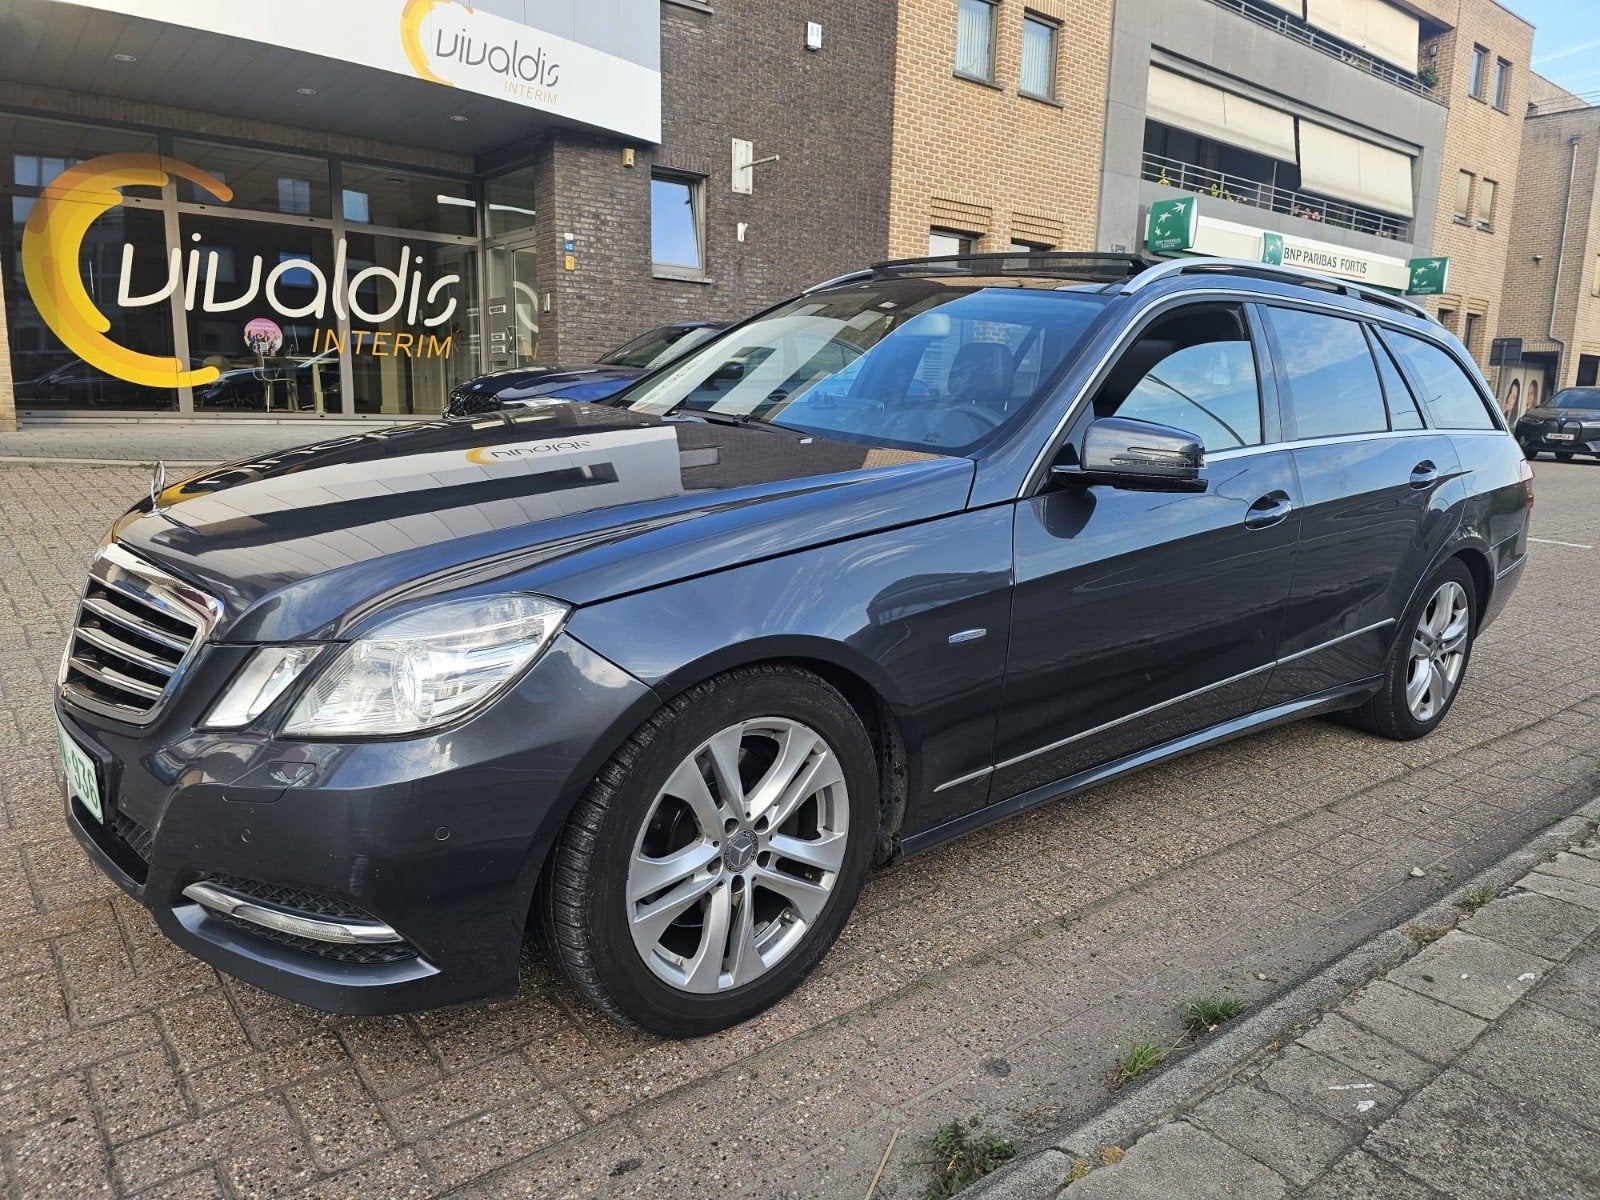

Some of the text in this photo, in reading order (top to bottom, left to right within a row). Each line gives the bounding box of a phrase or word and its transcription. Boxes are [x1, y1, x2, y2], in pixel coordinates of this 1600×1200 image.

[436, 28, 560, 87] vivaldis
[504, 80, 558, 105] INTERIM
[1284, 247, 1367, 273] BNP PARIBAS FORTIS
[117, 232, 460, 327] vivaldis
[312, 328, 453, 359] INTERIM
